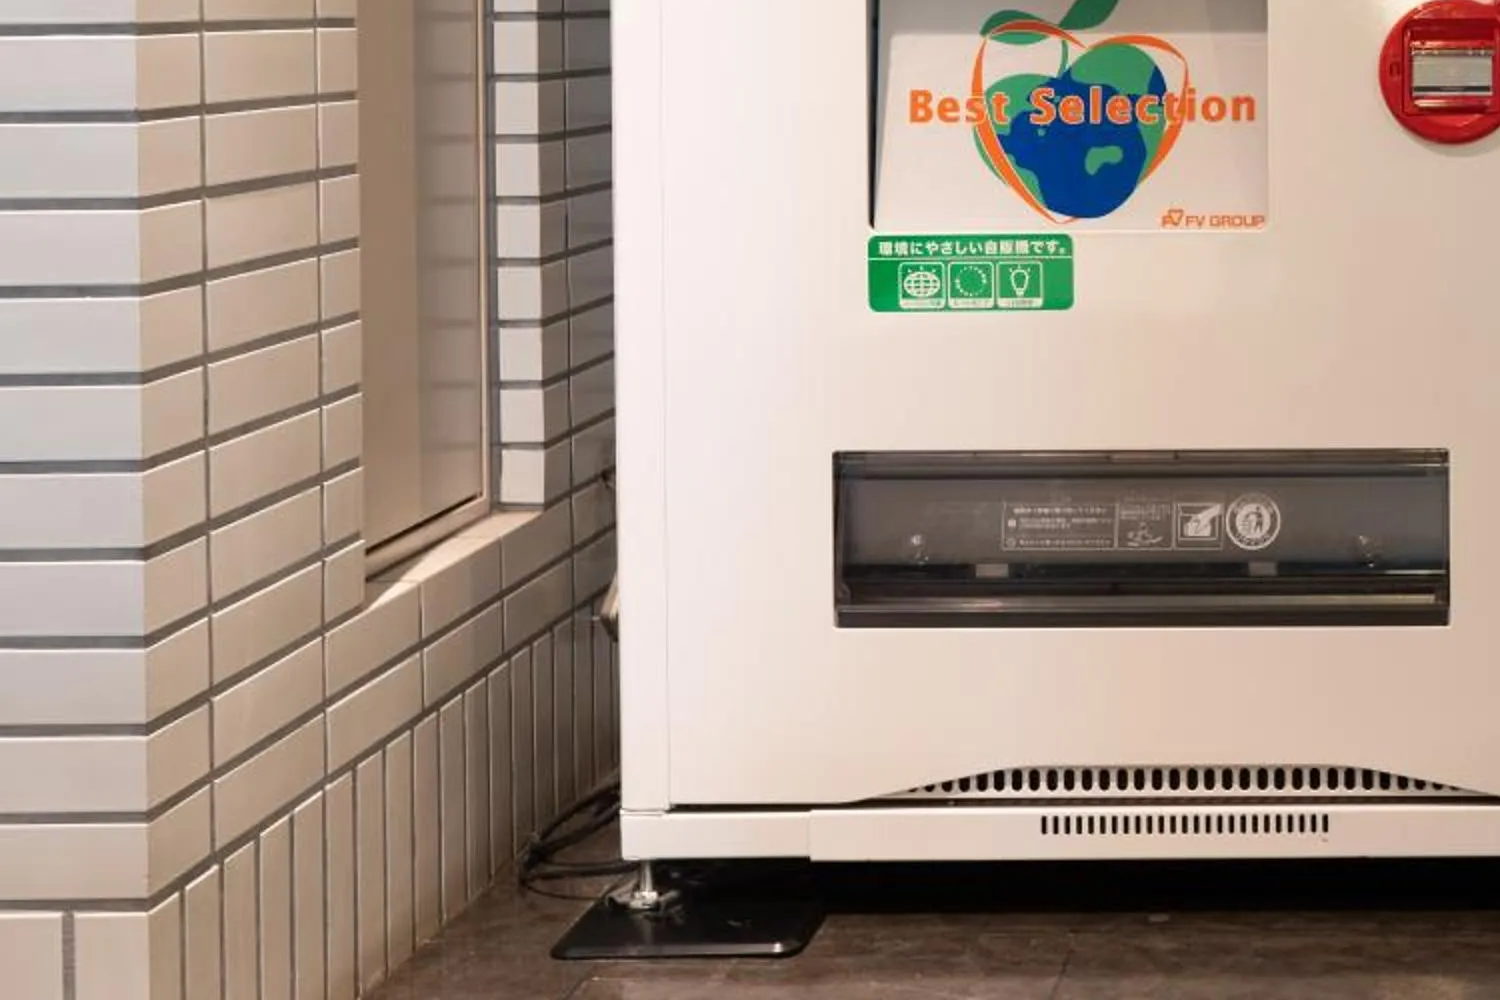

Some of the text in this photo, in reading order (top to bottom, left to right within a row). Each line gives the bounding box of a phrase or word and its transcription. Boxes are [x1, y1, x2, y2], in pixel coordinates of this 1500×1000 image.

[908, 87, 1256, 125] Best Selection
[1185, 214, 1266, 227] FV GROUP
[878, 239, 1066, 256] 環境にやさしい自販機です。
